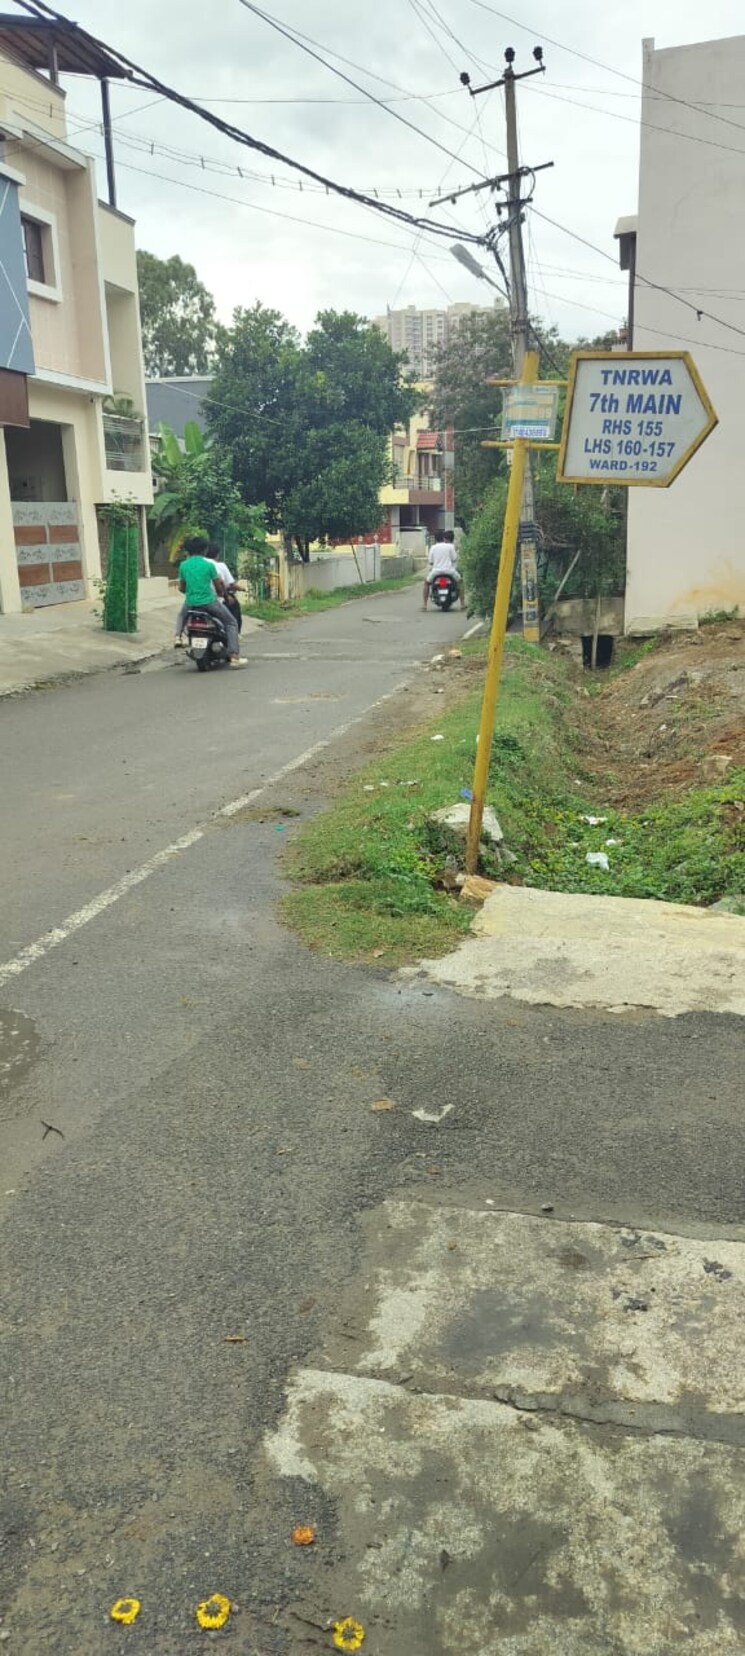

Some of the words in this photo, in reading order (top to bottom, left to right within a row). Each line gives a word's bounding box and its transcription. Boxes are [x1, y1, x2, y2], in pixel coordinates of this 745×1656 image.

[601, 370, 672, 386] TNRWA
[589, 393, 619, 413] 7th
[626, 394, 682, 415] MAIN
[602, 419, 632, 435] RHS
[637, 420, 663, 436] 155
[584, 438, 611, 454] LHS
[616, 440, 675, 457] 160-157
[589, 459, 657, 471] WARD-192
